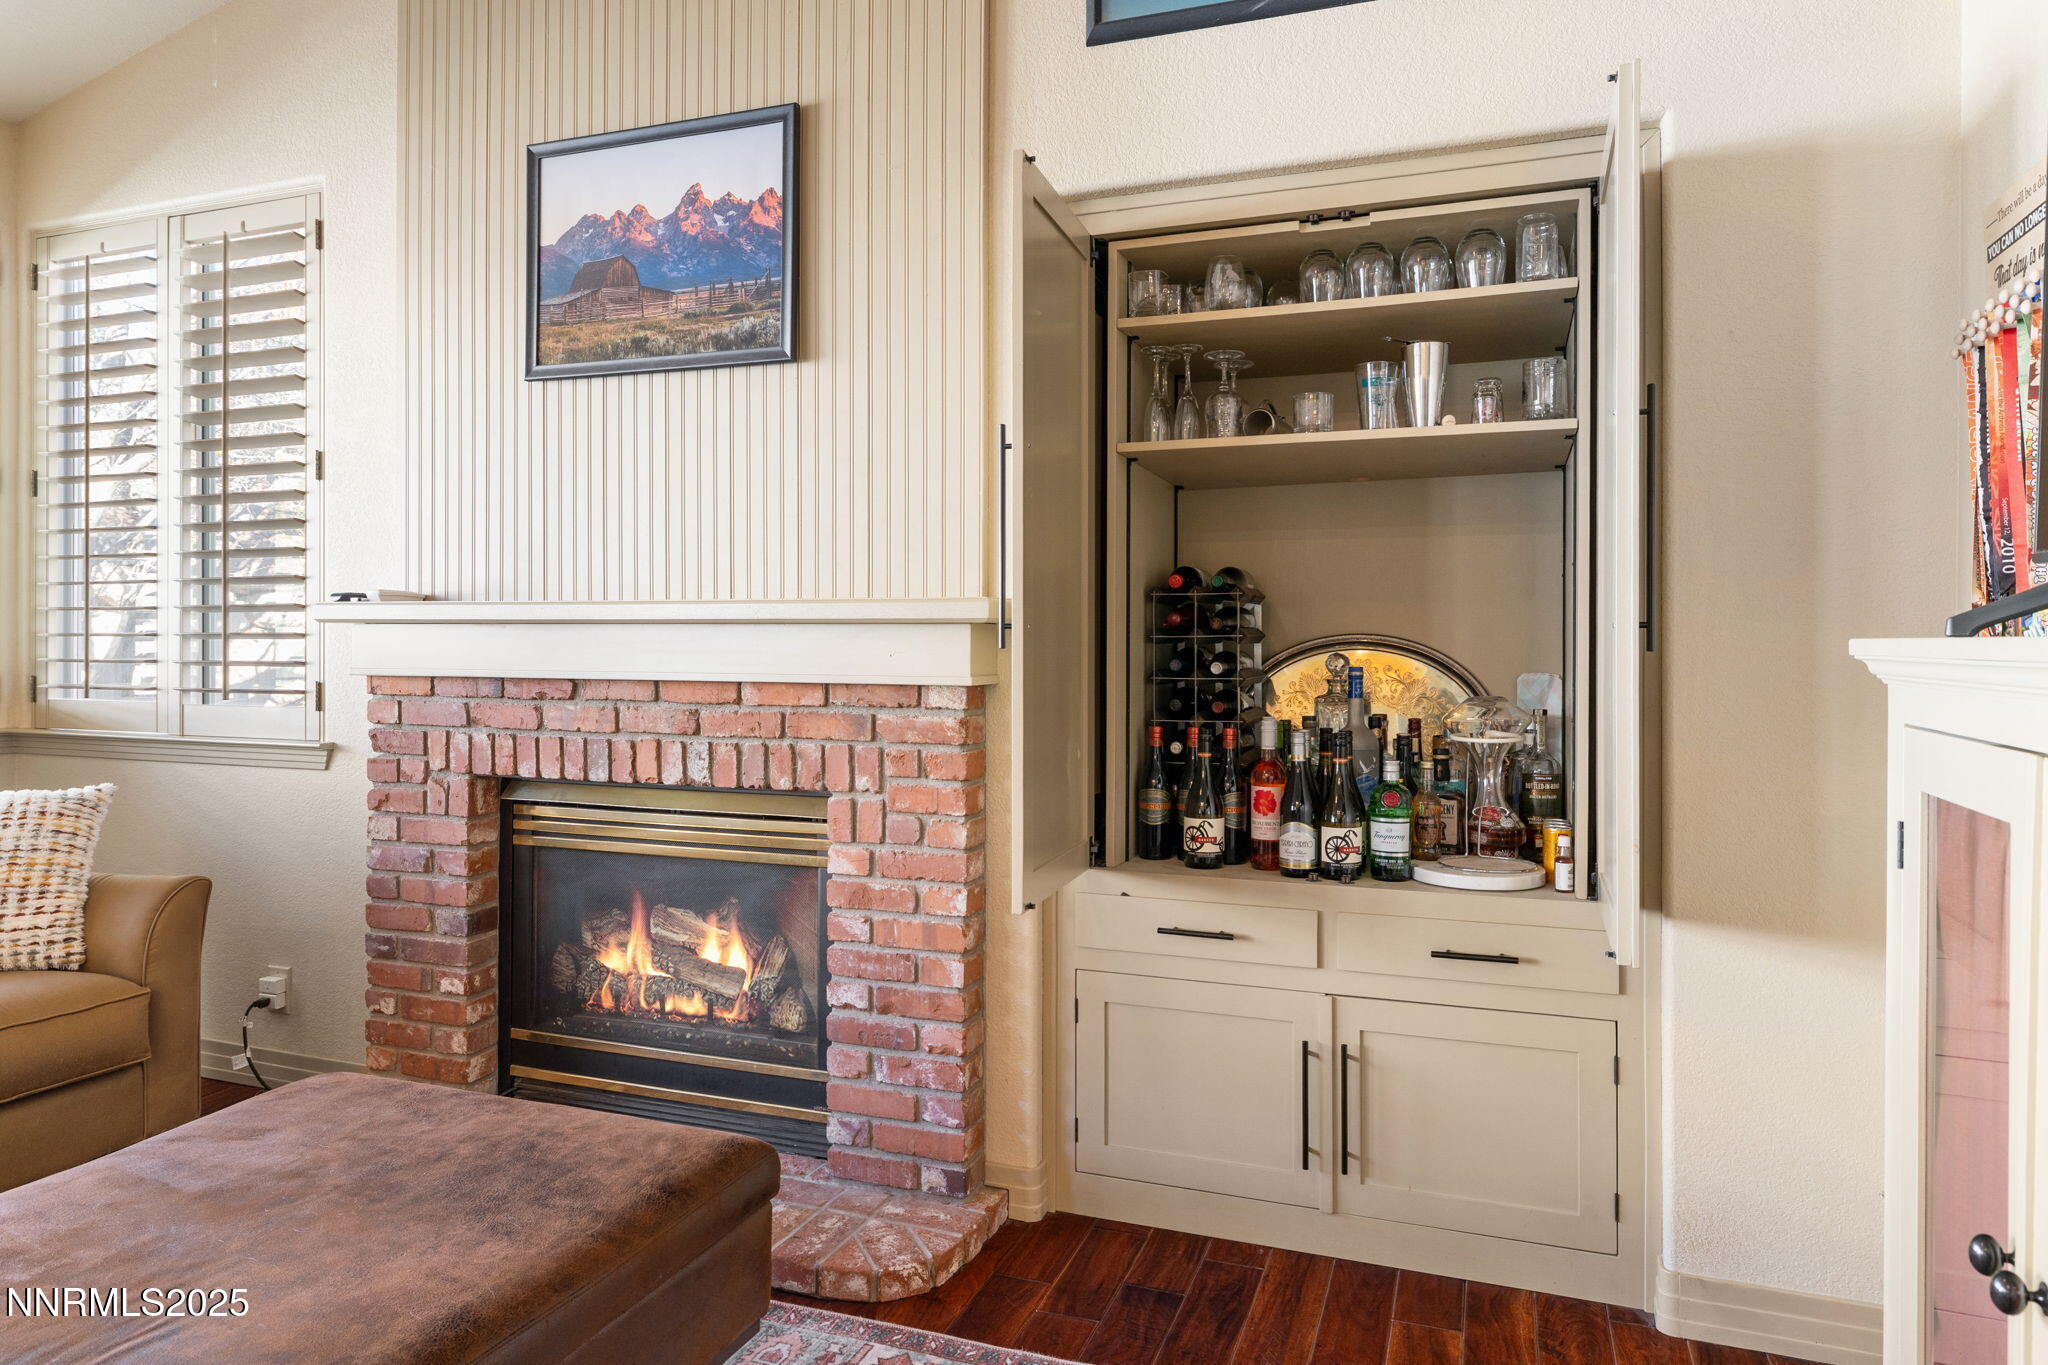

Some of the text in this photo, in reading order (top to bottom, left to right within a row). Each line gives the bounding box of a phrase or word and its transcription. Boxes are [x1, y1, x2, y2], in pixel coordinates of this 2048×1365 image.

[1988, 240, 2001, 261] YOU
[2001, 229, 2014, 250] CAN
[2014, 222, 2025, 241] NO
[1994, 259, 2012, 288] That
[2013, 254, 2028, 278] day
[2029, 246, 2036, 265] is
[2001, 497, 2010, 526] September
[2001, 538, 2016, 574] 2010
